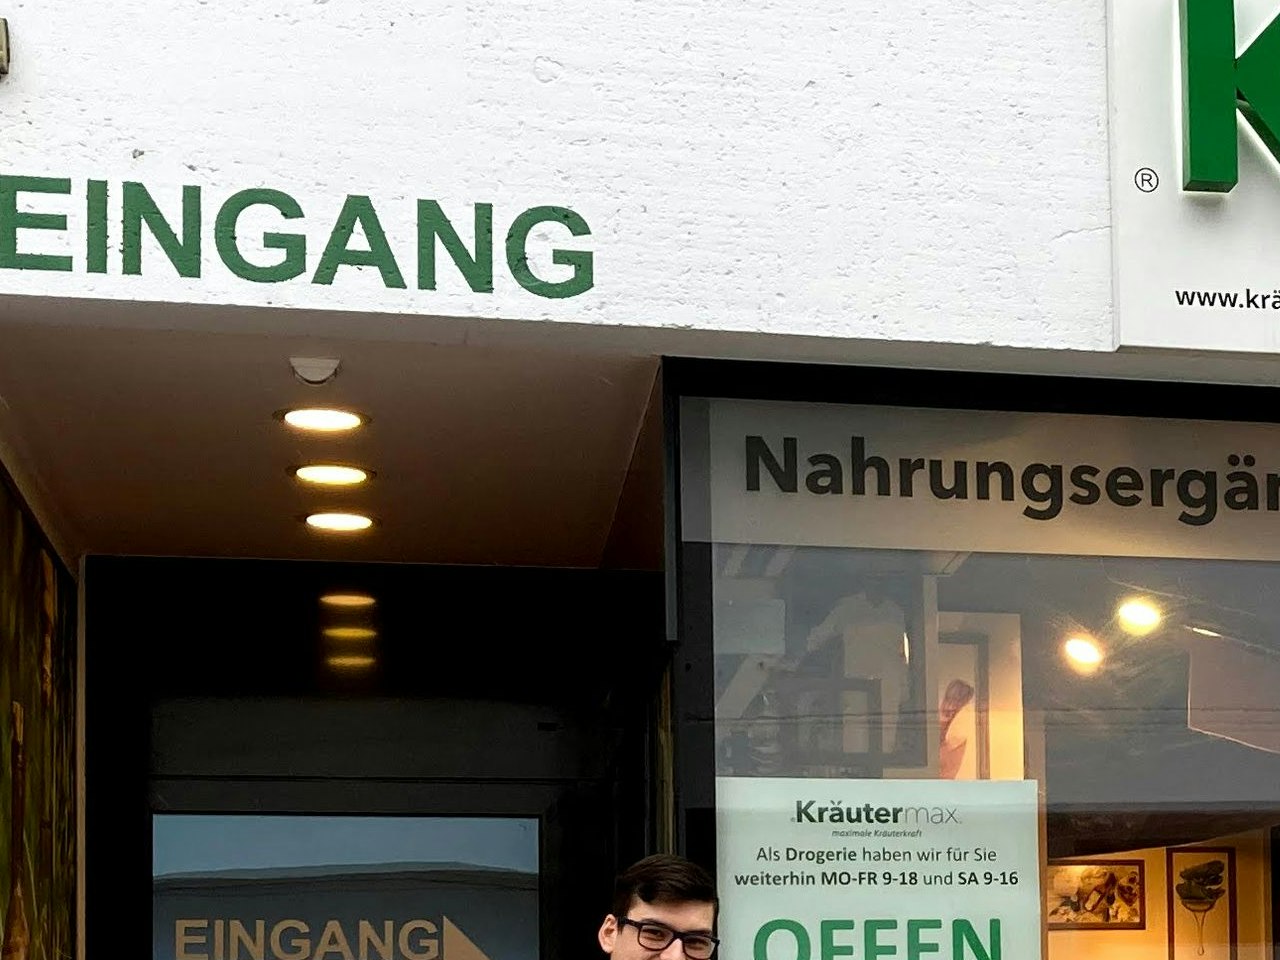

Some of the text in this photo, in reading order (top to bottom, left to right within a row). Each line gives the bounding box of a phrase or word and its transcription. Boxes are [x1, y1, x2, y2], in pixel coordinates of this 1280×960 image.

[0, 174, 595, 299] EINGANG
[756, 846, 997, 866] Als Drogerie haben wir für Sie
[734, 870, 1019, 886] weiterhin MO-FR 9-18 und SA 9-16
